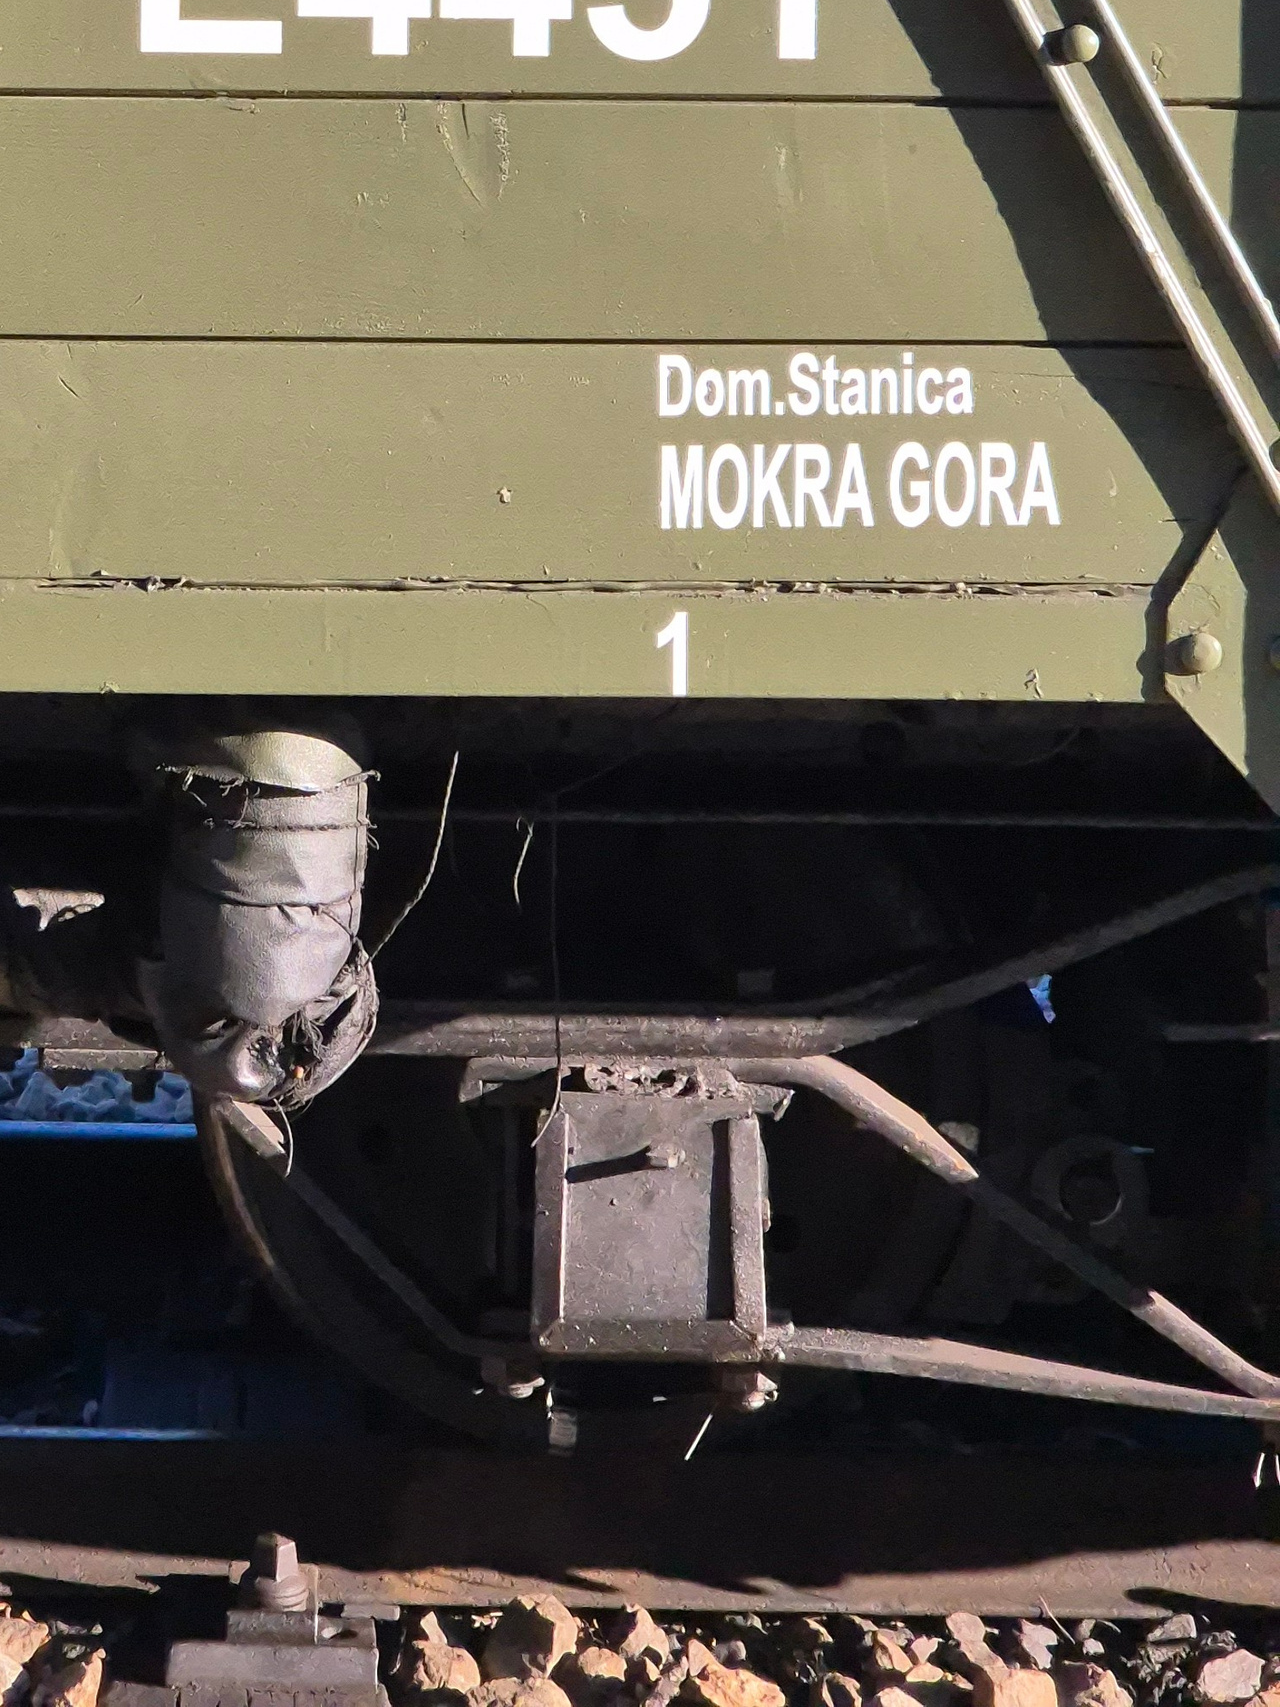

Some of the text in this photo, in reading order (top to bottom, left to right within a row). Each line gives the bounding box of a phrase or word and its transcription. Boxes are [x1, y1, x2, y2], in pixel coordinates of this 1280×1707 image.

[656, 351, 975, 418] Dom.Stanica
[658, 441, 1062, 530] MOKRA GORA
[655, 610, 690, 697] 1
